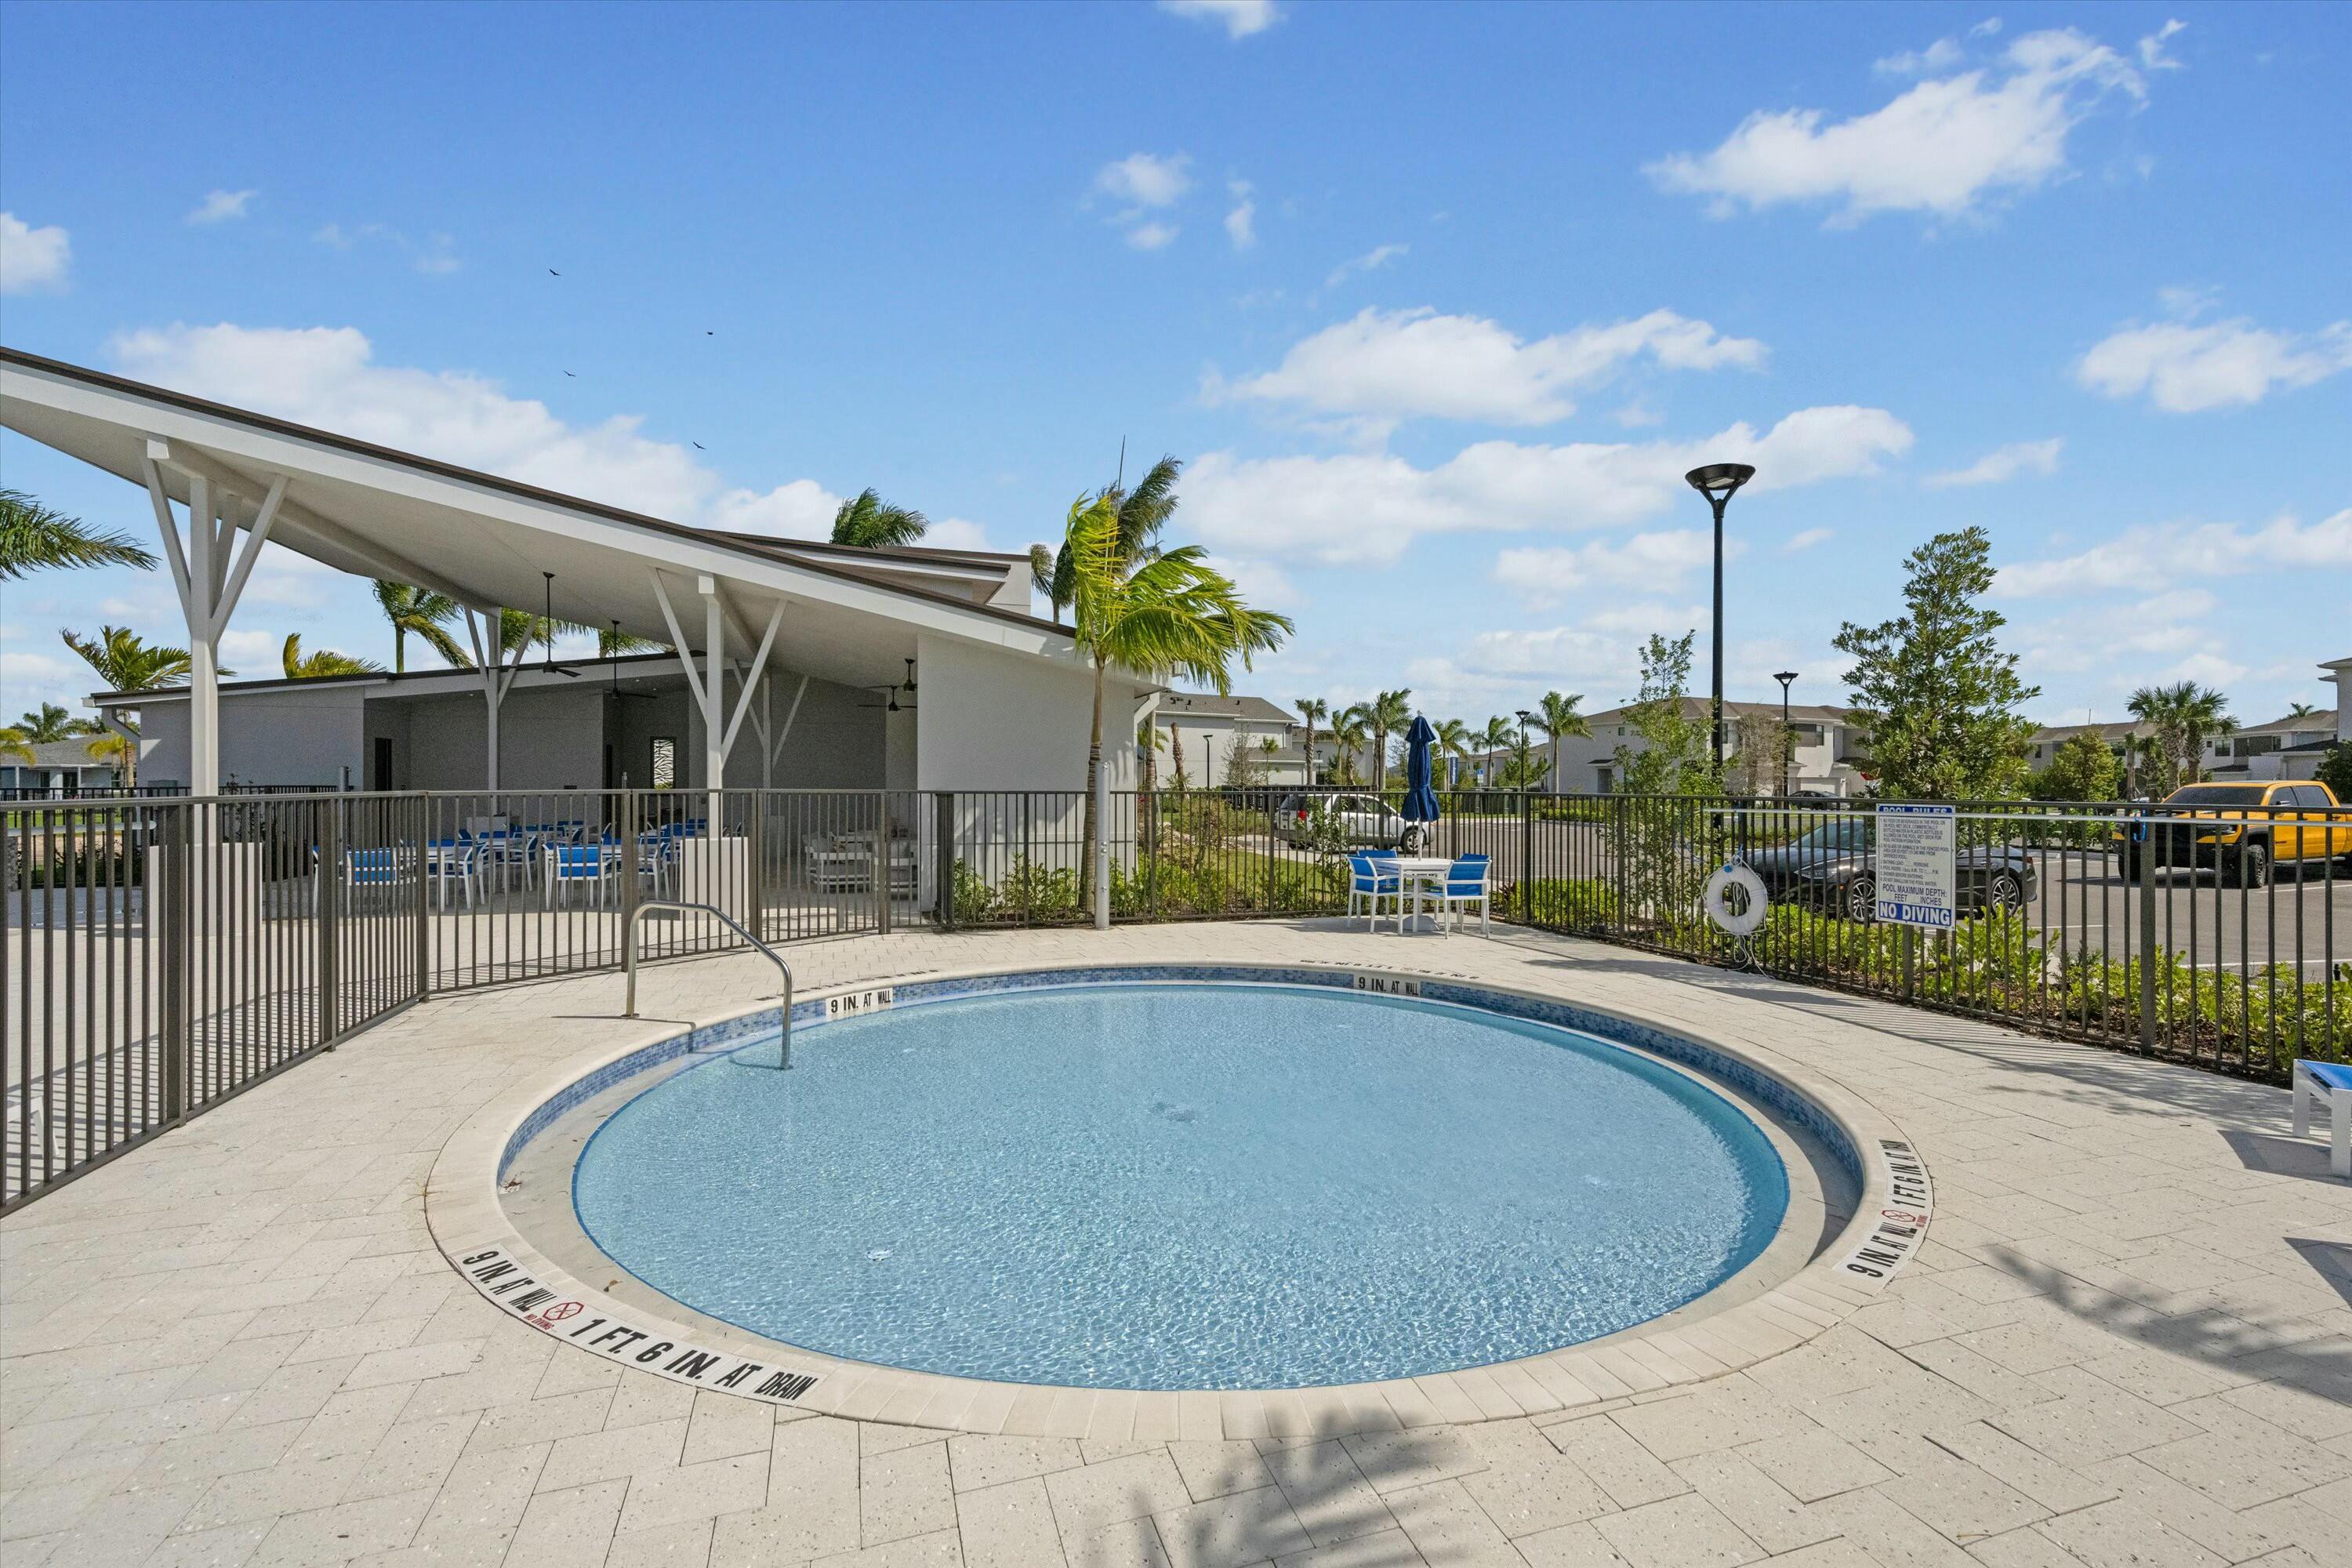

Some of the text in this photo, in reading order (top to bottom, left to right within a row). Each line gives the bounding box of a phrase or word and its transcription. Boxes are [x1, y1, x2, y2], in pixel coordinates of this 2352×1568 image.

[1882, 884, 1947, 898] POOL MAXIMUM DEPTH:
[1895, 894, 1942, 906] FEET INCHES
[1880, 902, 1950, 925] NO DIVING
[1359, 977, 1418, 996] 9 IN. AT WALL
[831, 990, 891, 1013] 9 IN. AT WALL
[1885, 1152, 1917, 1162] AT
[1889, 1163, 1922, 1175] IN.
[1893, 1175, 1924, 1185] 6
[1893, 1184, 1926, 1200] FT.
[1892, 1199, 1925, 1208] 1
[1846, 1221, 1918, 1278] 9 IN. AT WALL
[463, 1250, 557, 1312] 9 IN. AT WALL
[568, 1318, 818, 1400] 1 FT. 6 IN. AT DRAIN
